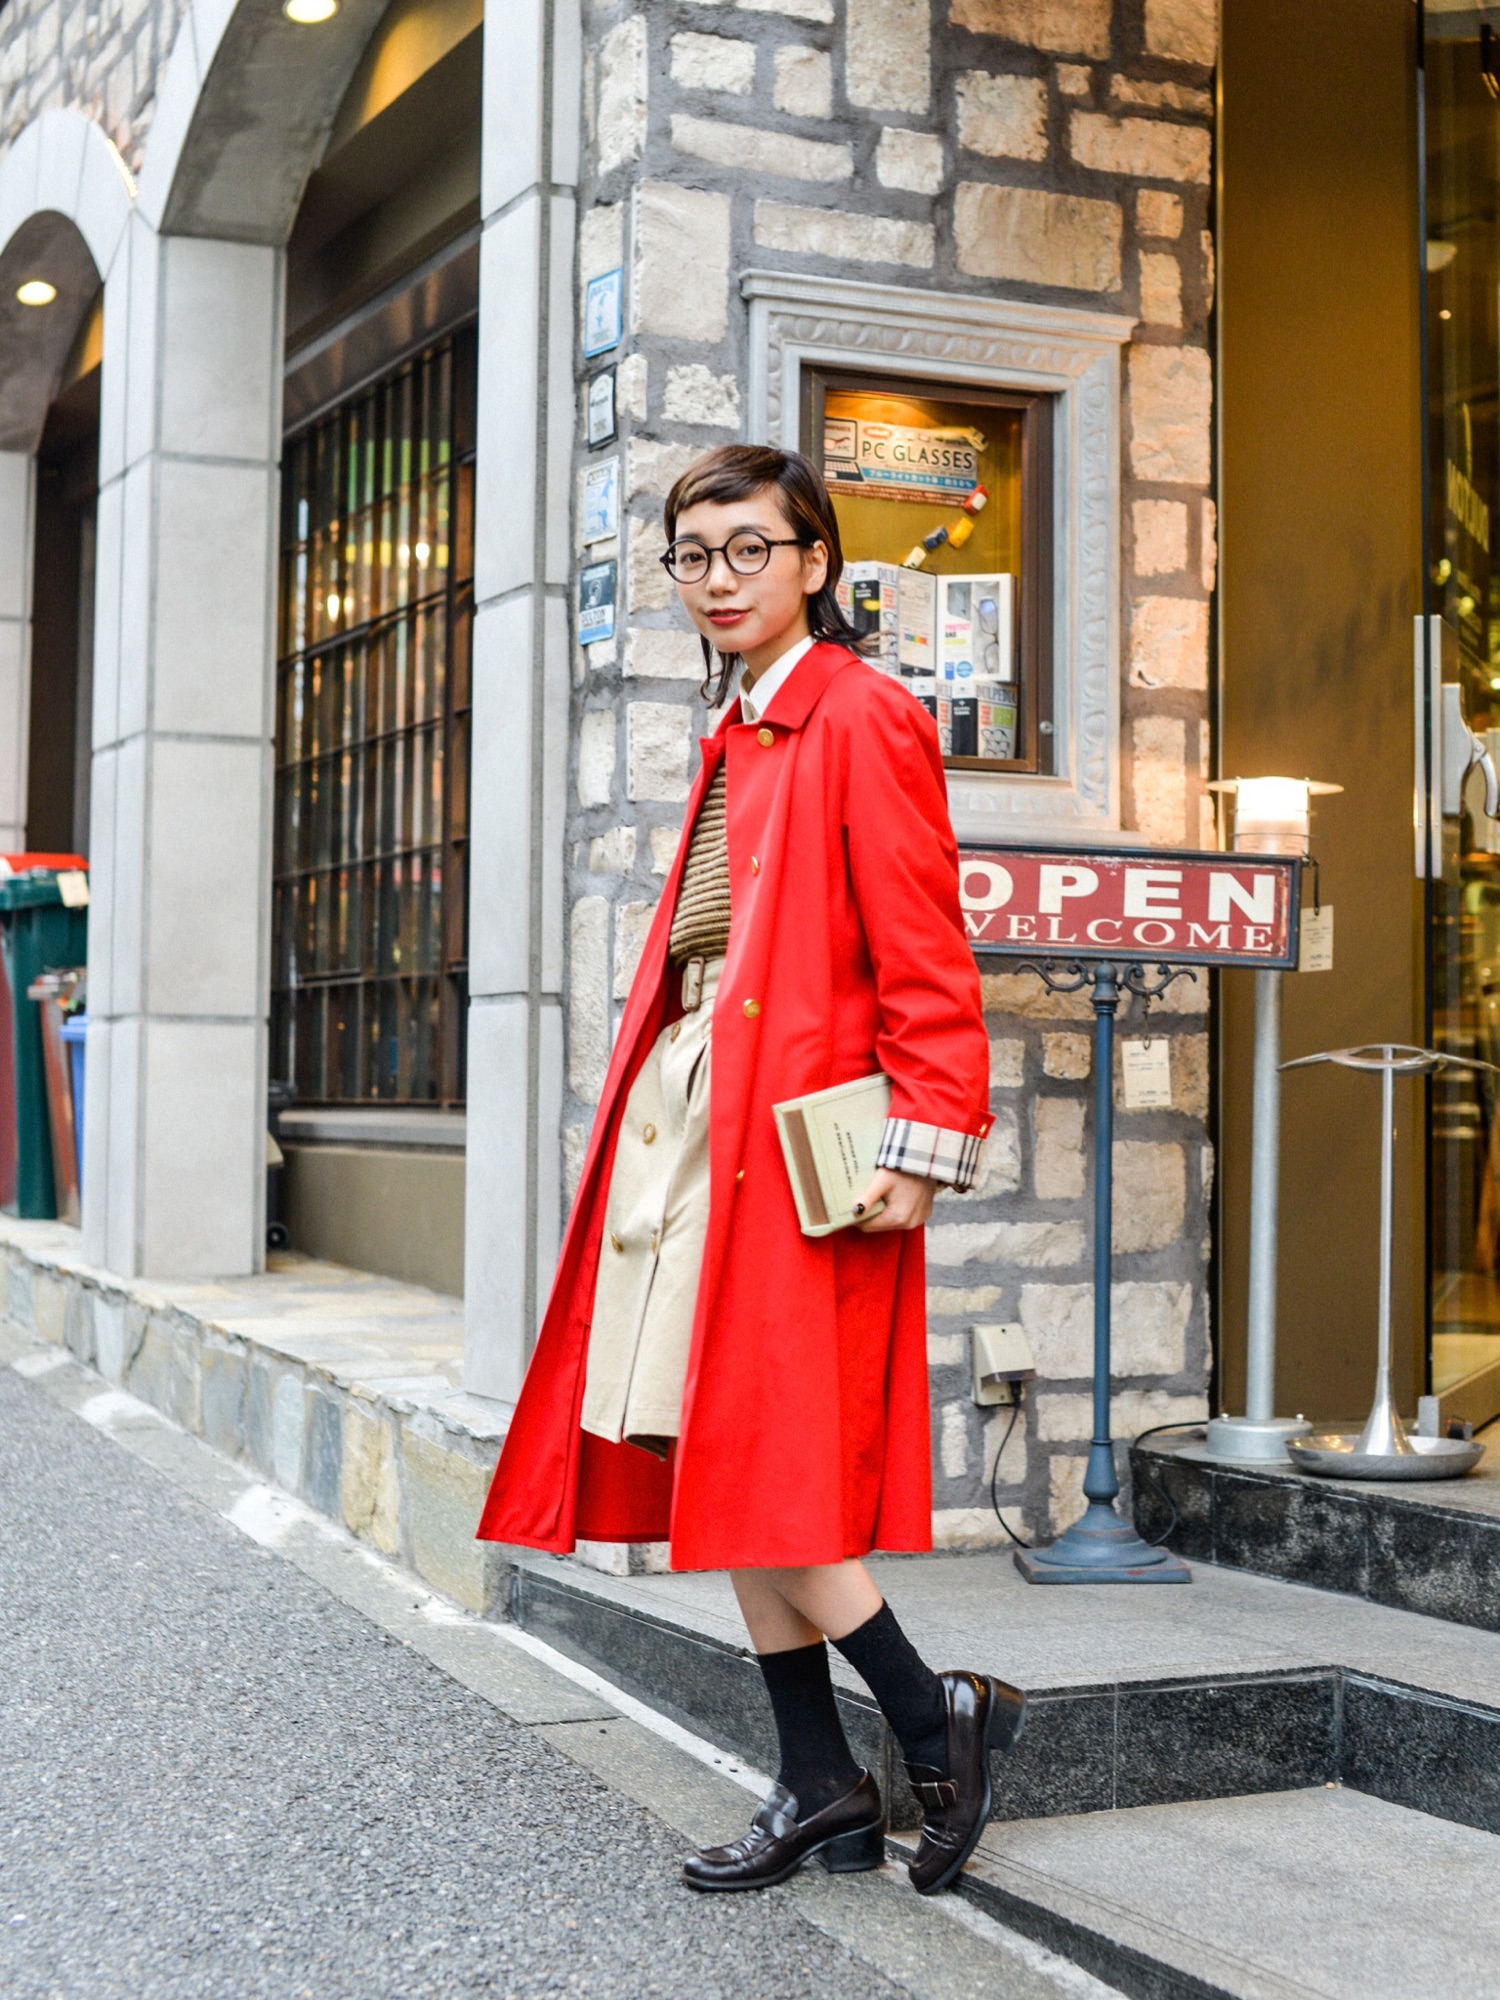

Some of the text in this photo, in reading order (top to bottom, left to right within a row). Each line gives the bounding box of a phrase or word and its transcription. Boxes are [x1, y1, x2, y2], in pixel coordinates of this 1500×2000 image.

[862, 441, 973, 469] PC GLASSES
[959, 860, 1276, 924] OPEN
